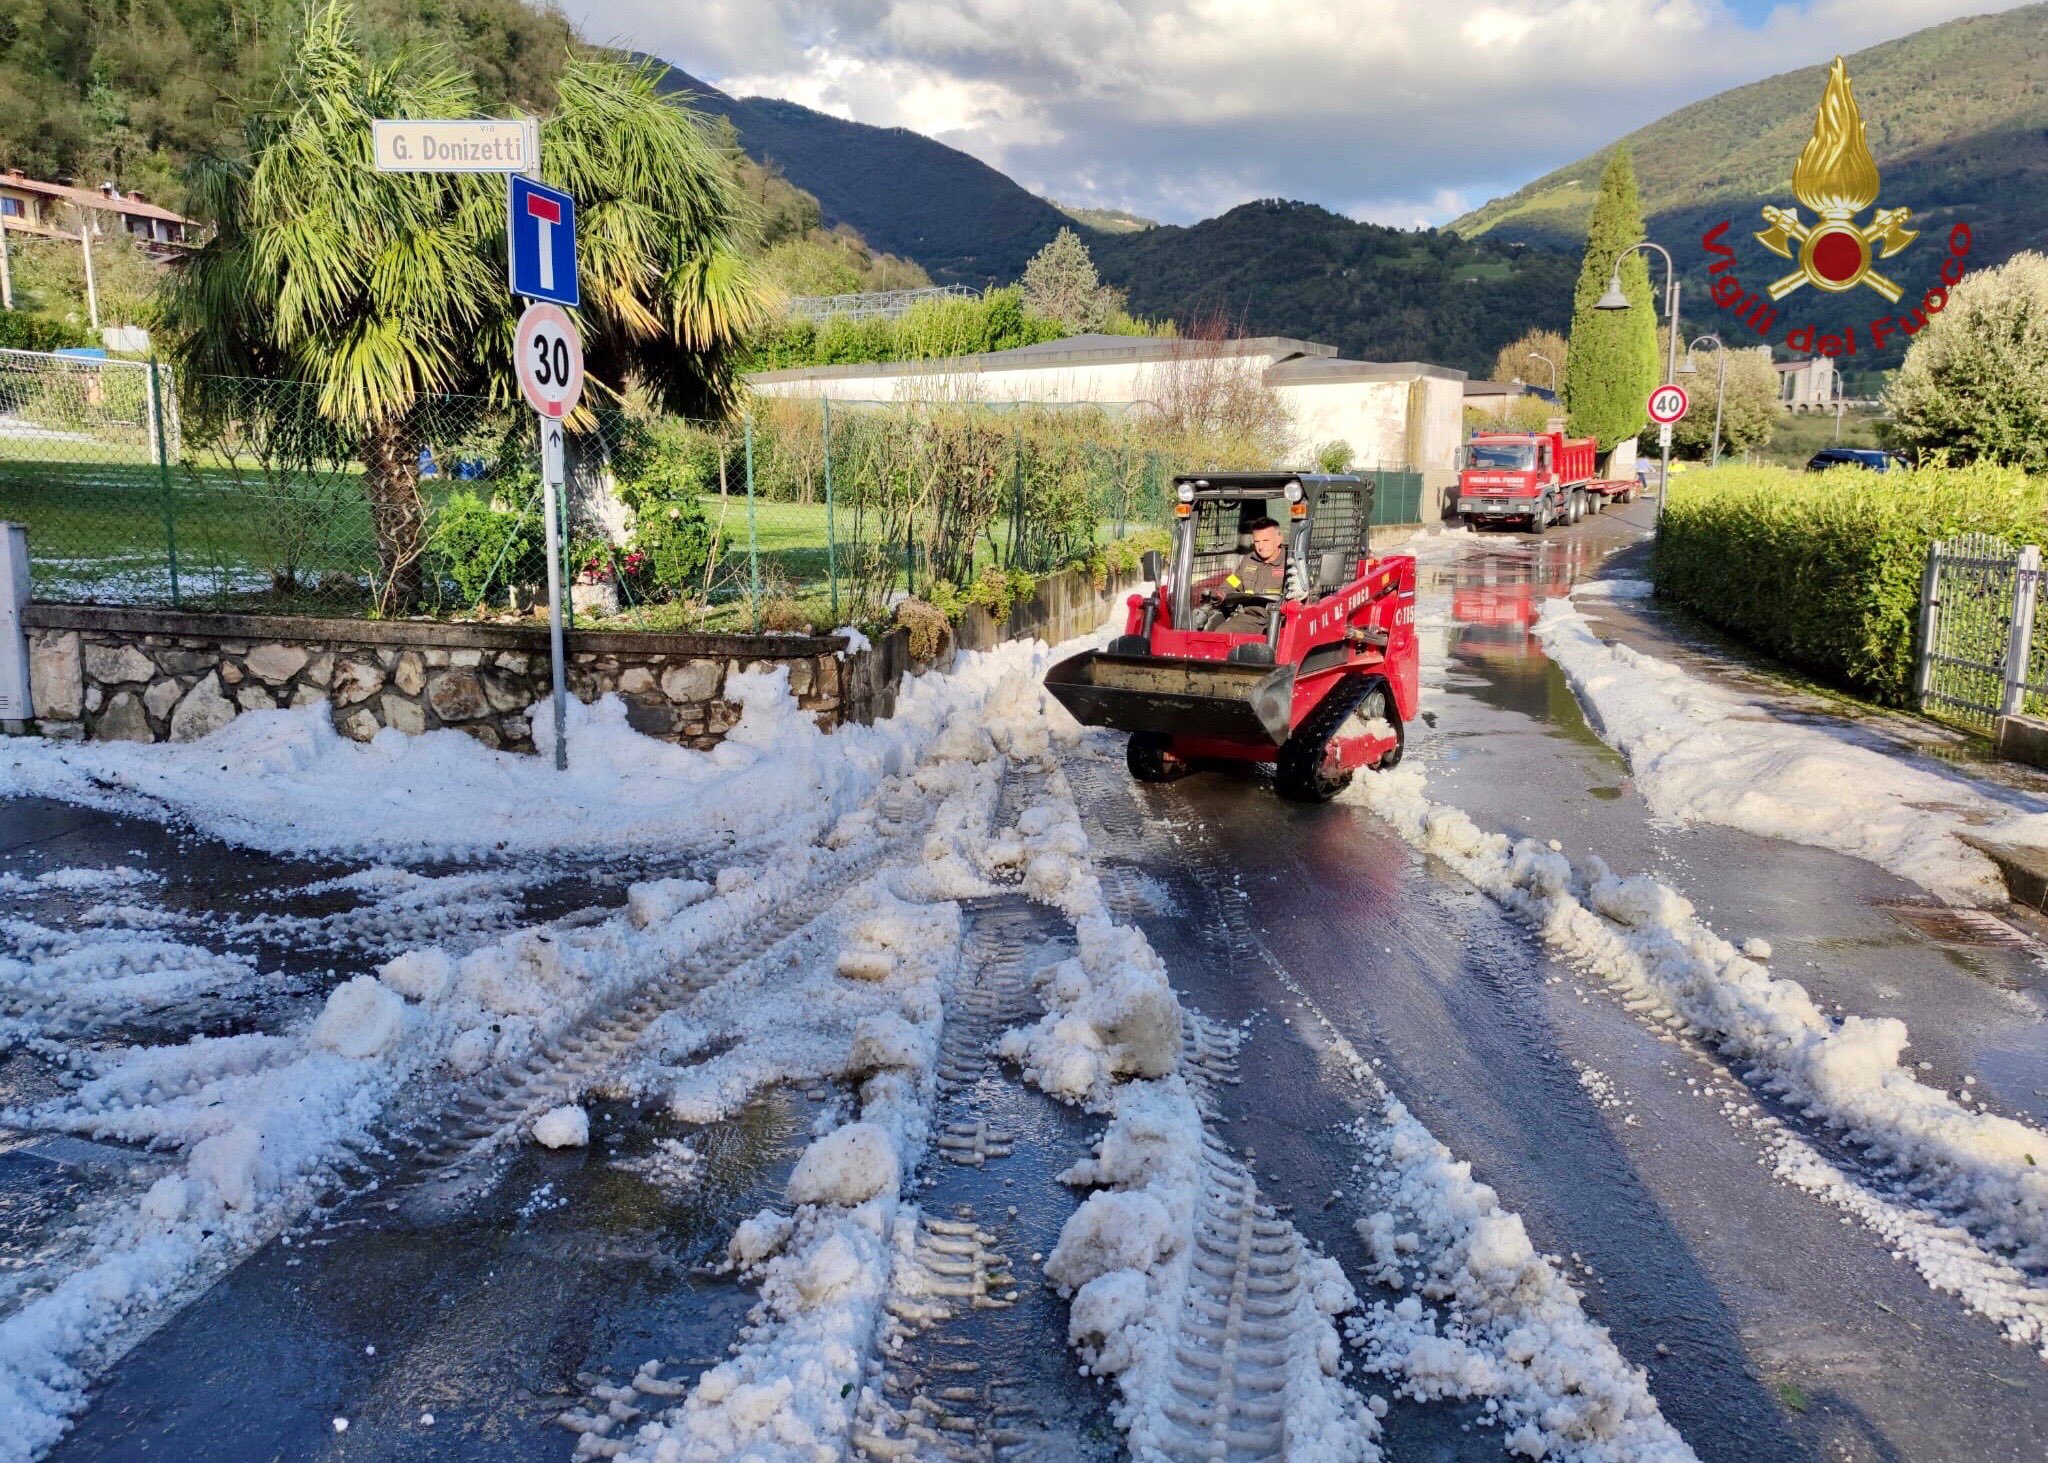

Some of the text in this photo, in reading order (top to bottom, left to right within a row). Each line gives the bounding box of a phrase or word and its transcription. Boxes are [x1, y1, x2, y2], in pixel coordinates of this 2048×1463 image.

[392, 135, 521, 161] G. Donizetti
[533, 334, 569, 388] 30
[1656, 396, 1680, 412] 40
